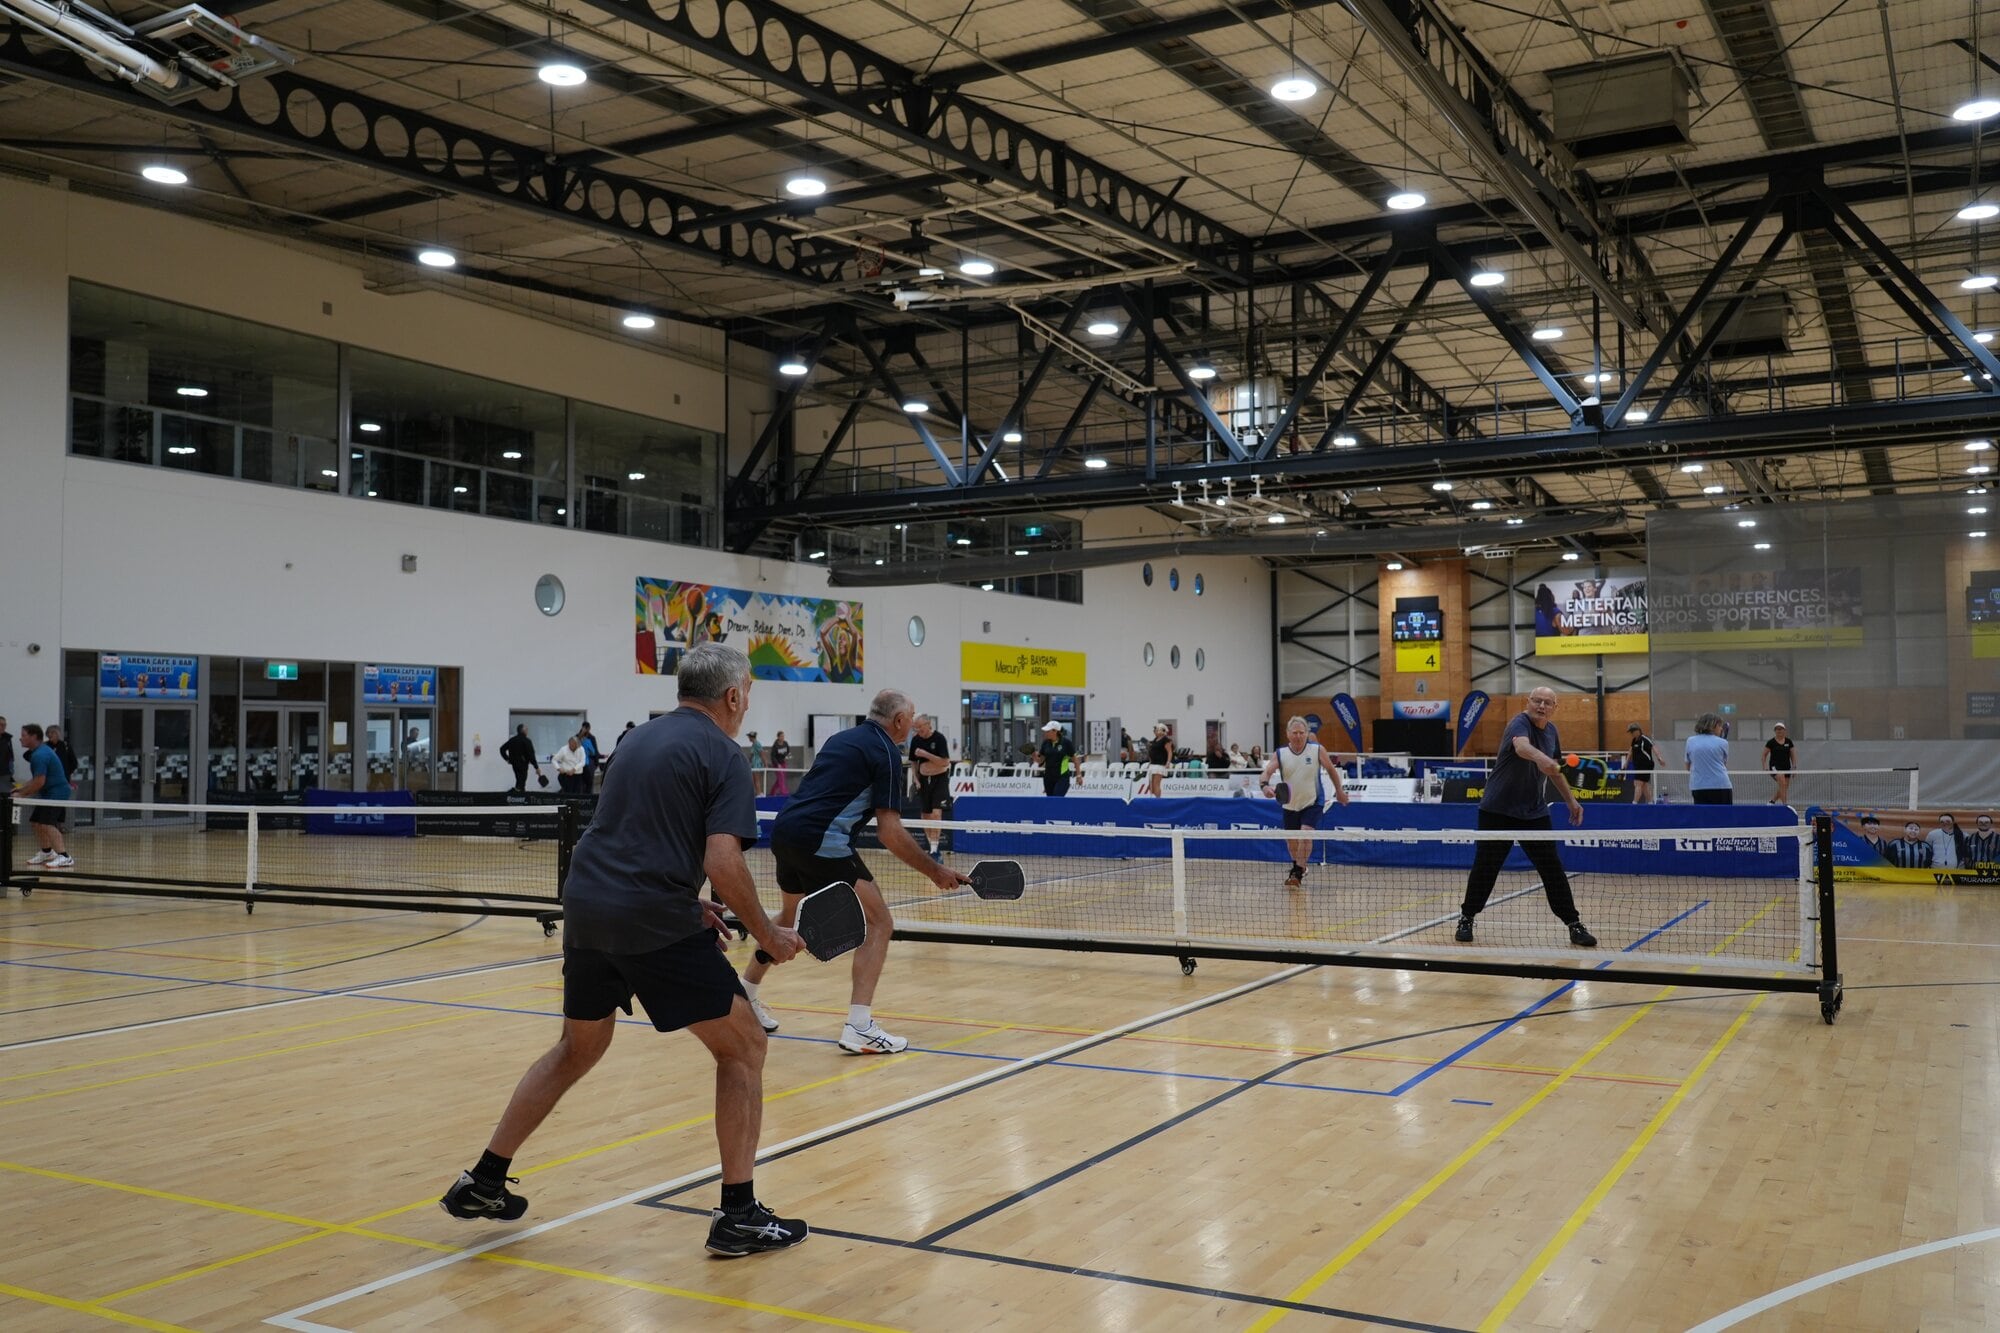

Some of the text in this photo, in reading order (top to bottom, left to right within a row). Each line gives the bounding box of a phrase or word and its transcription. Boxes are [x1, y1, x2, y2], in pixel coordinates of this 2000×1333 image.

[1560, 611, 1641, 628] MEETINGS.
[1706, 606, 1771, 622] SPORTS
[1775, 605, 1787, 620] &
[127, 657, 150, 665] ARENA
[1030, 654, 1058, 666] BAYPARK
[1425, 654, 1436, 667] 4
[995, 659, 1020, 678] Mercury
[1031, 666, 1048, 676] ARENA
[1010, 782, 1032, 790] MORA
[1100, 783, 1124, 791] MORA
[1163, 783, 1225, 792] INGHAM MORA
